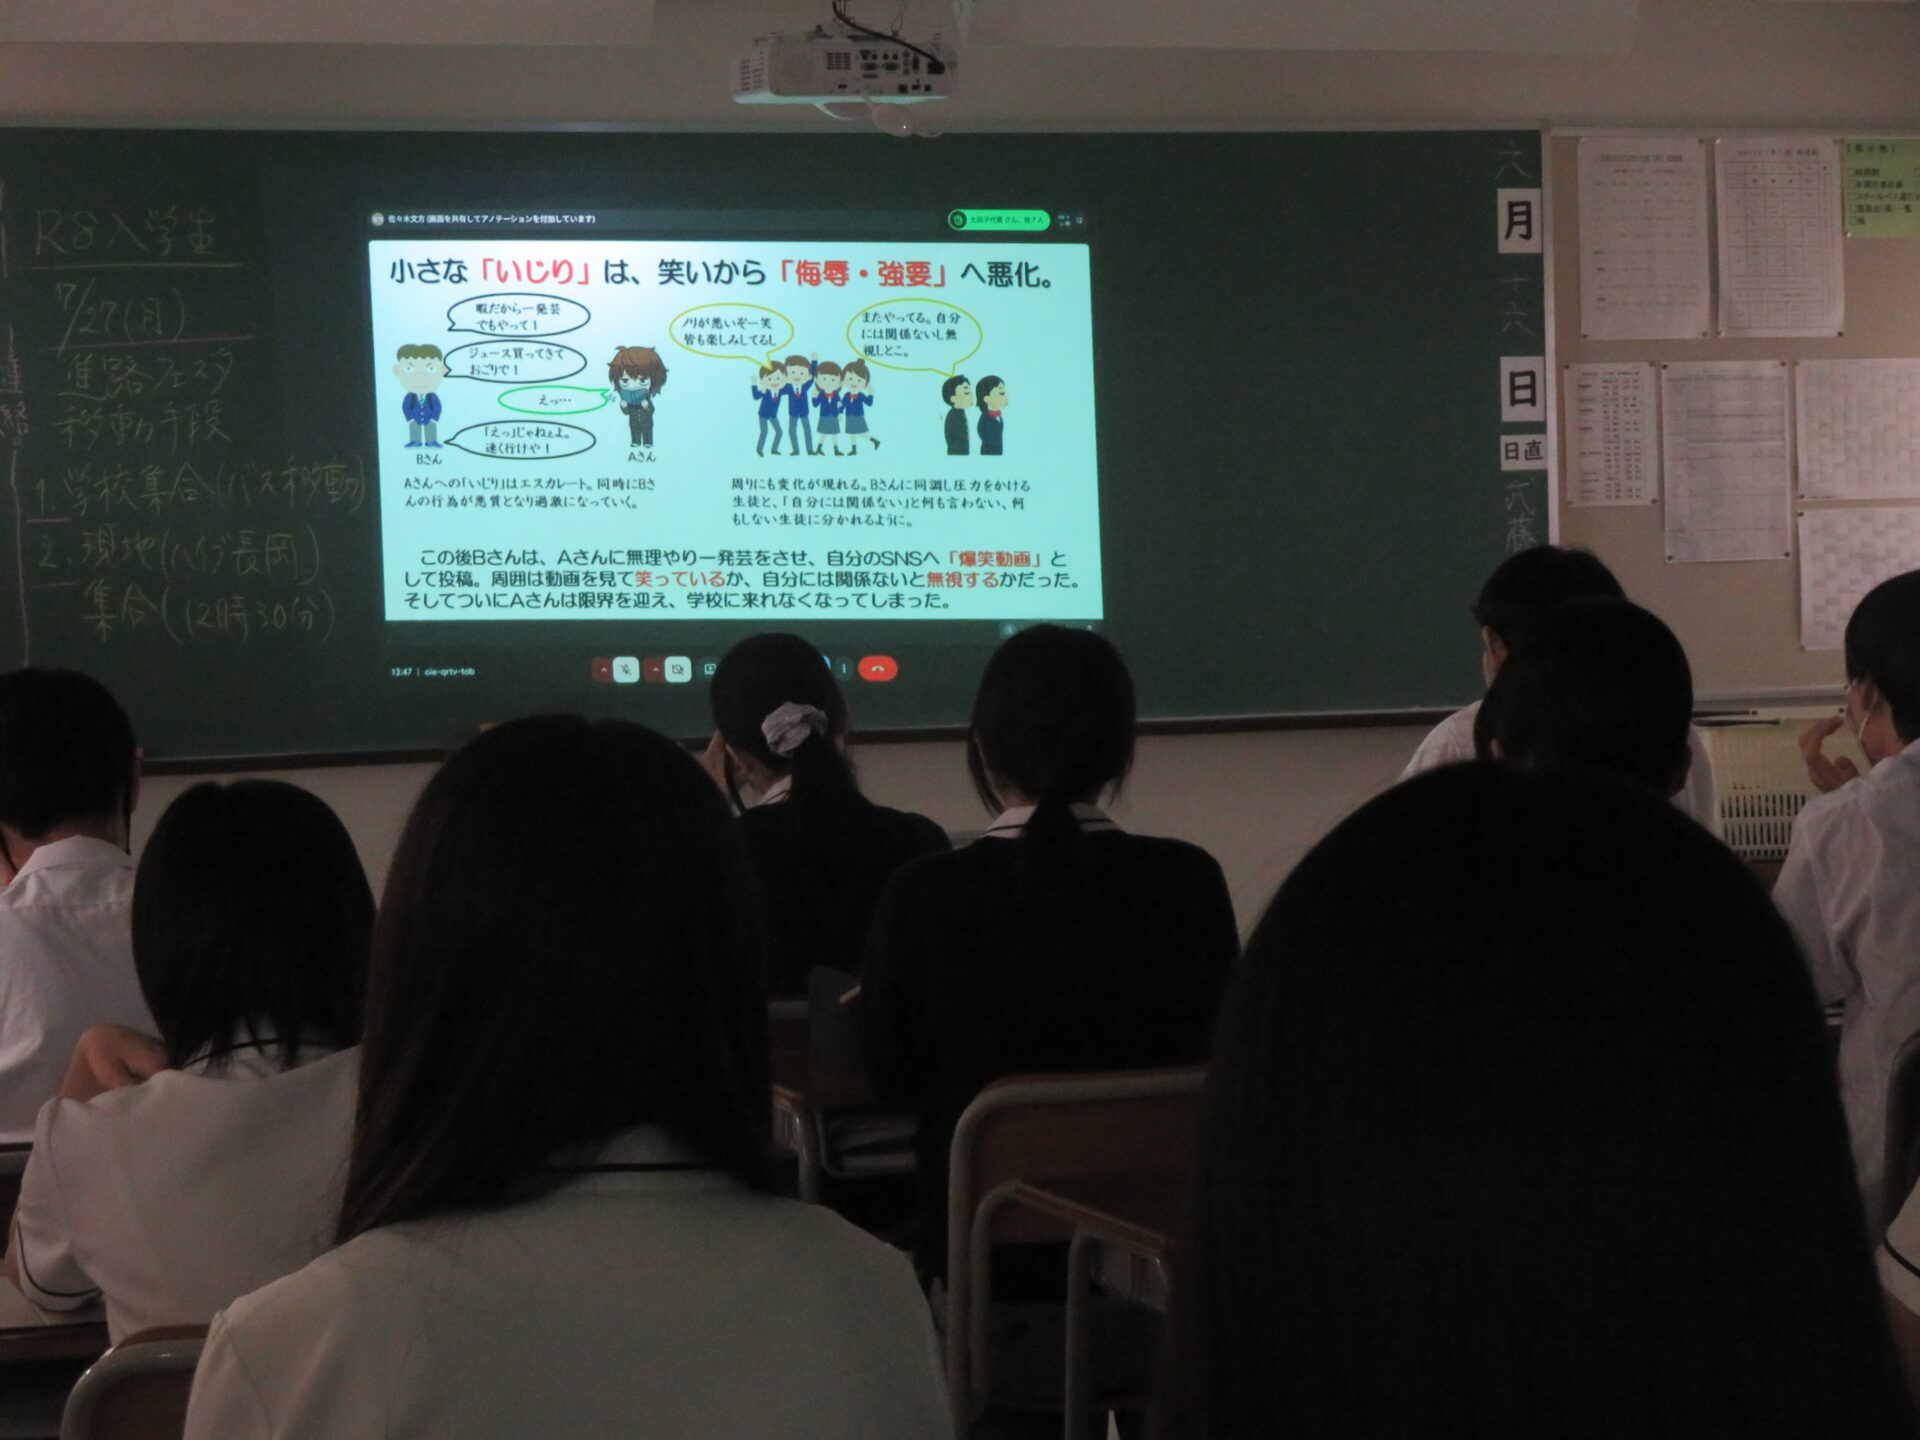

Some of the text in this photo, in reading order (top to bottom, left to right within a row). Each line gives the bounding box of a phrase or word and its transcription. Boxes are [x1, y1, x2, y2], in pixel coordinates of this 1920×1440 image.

[1505, 200, 1533, 241] 月
[390, 257, 1052, 289] 小さな「いじり」は、笑いから「侮辱・強要」へ悪化。
[475, 303, 562, 316] 暇だから一発芸
[862, 311, 962, 325] またやってる。自分
[861, 328, 958, 341] には関係ないし無
[469, 347, 565, 360] ジュース買ってきて
[863, 344, 910, 357] 視しとこ。
[1509, 370, 1538, 409] 日
[627, 452, 657, 463] Aさん
[1504, 440, 1544, 461] 日直
[415, 454, 443, 466] Bさん
[403, 477, 656, 492] Aさんへの「いじり」はエスカレート。同時にBさ
[731, 477, 1031, 492] 周りにも変化が現れる。Bさんに同調し圧力をかける
[404, 494, 638, 509] んの行為が悪質となり過激になっていく。
[732, 496, 1025, 510] 生徒と、「自分には関係ない」と何も言わない、何
[732, 512, 914, 527] もしない生徒に分かれるように。
[421, 549, 1068, 567] この後Bさんは、Aさんに無理やり一発芸をさせ、自分のSNSへ「爆笑動画」と
[404, 570, 1079, 589] して投稿。周囲は動画を見て笑っているか、自分には関係ないと無視するかだった。
[404, 591, 951, 611] そしてついにAさんは限界を迎え、学校に来れなくなってしまった。
[391, 667, 413, 677] 13:47
